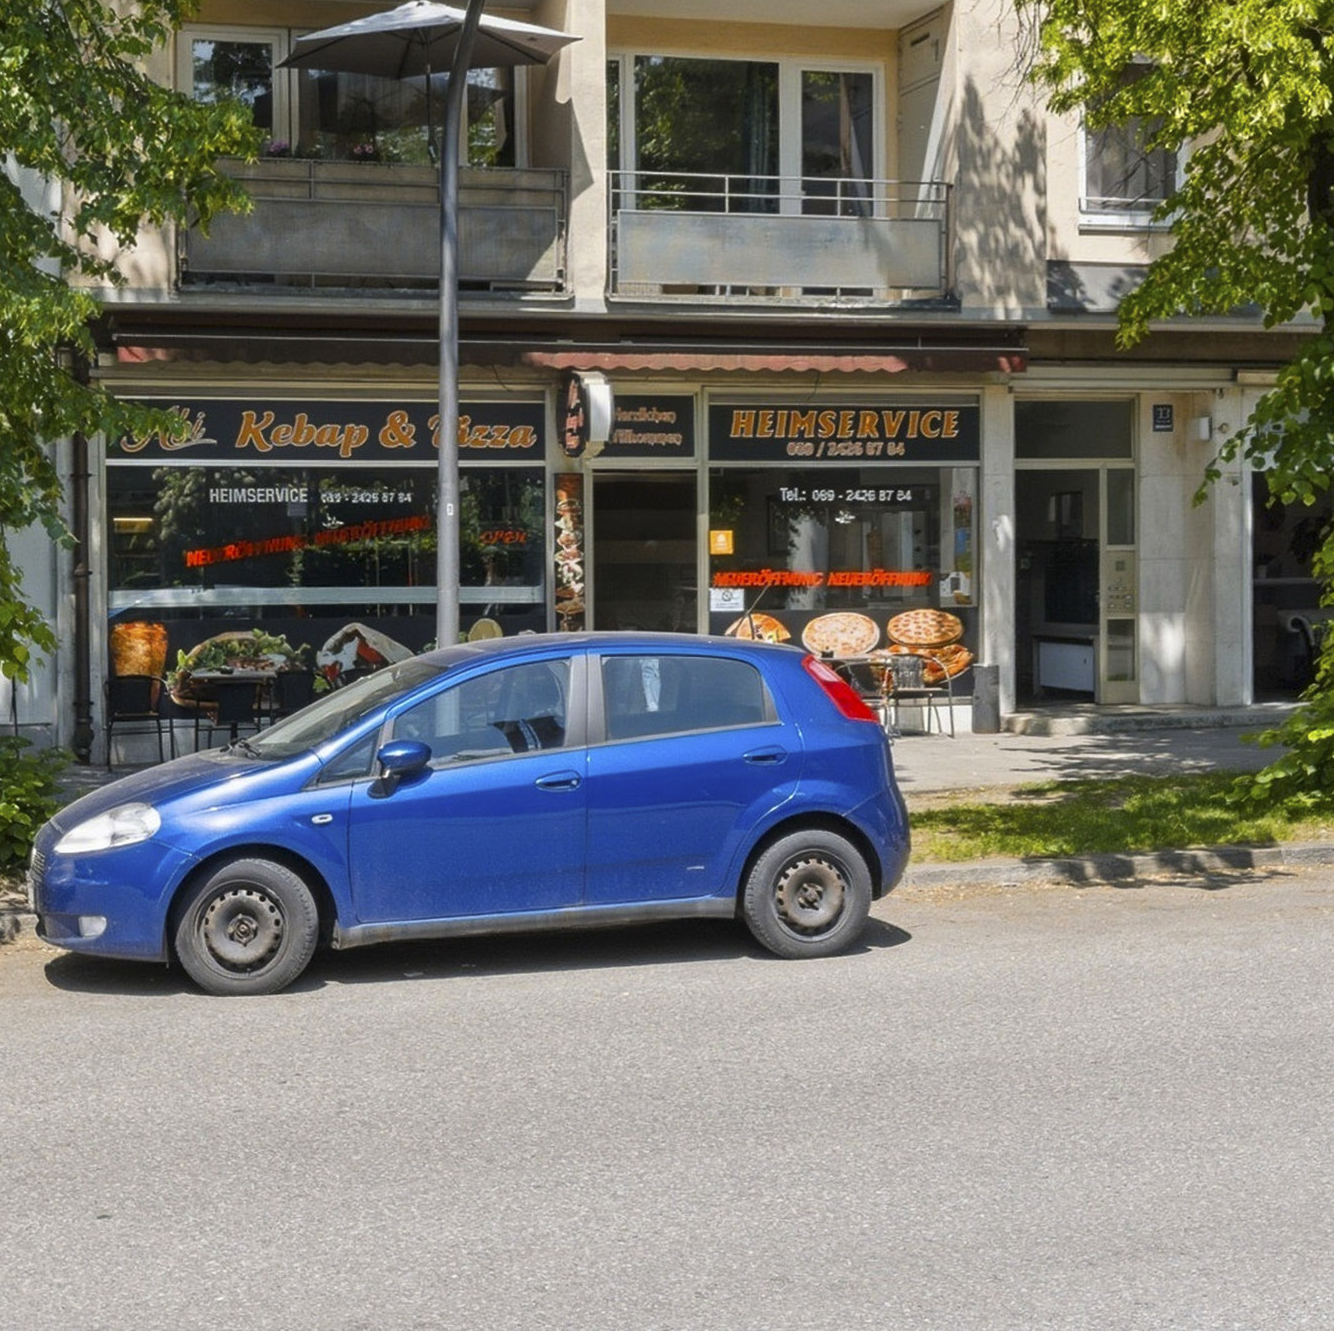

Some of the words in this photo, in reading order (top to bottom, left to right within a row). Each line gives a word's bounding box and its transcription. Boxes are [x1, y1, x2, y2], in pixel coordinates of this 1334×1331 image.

[729, 409, 960, 438] HEIMSERVICE
[234, 410, 369, 457] Kebap
[379, 410, 417, 449] &
[209, 487, 309, 503] HEIMSERVICE
[780, 487, 807, 502] Tel.:
[713, 569, 824, 587] NEUERÖFFNUNG
